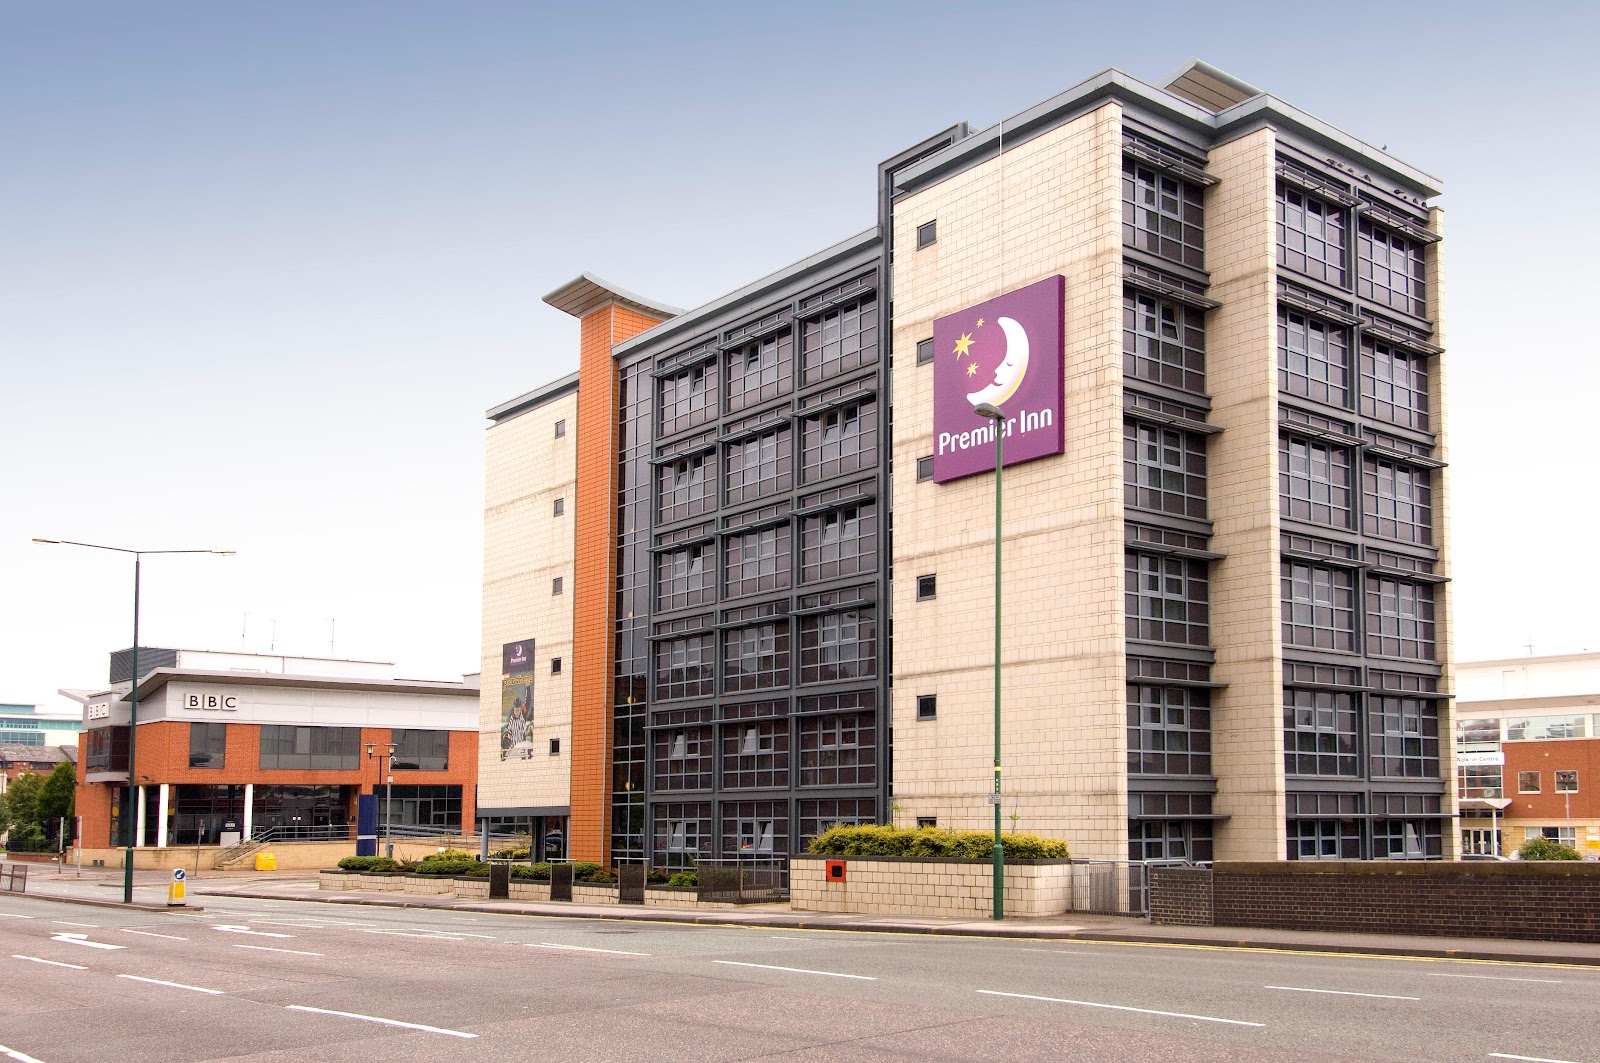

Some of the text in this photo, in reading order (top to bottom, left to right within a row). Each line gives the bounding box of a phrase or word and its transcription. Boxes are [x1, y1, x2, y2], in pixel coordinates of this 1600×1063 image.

[939, 409, 1052, 455] Premier Inn
[189, 695, 236, 708] BBC
[89, 704, 106, 718] BBC
